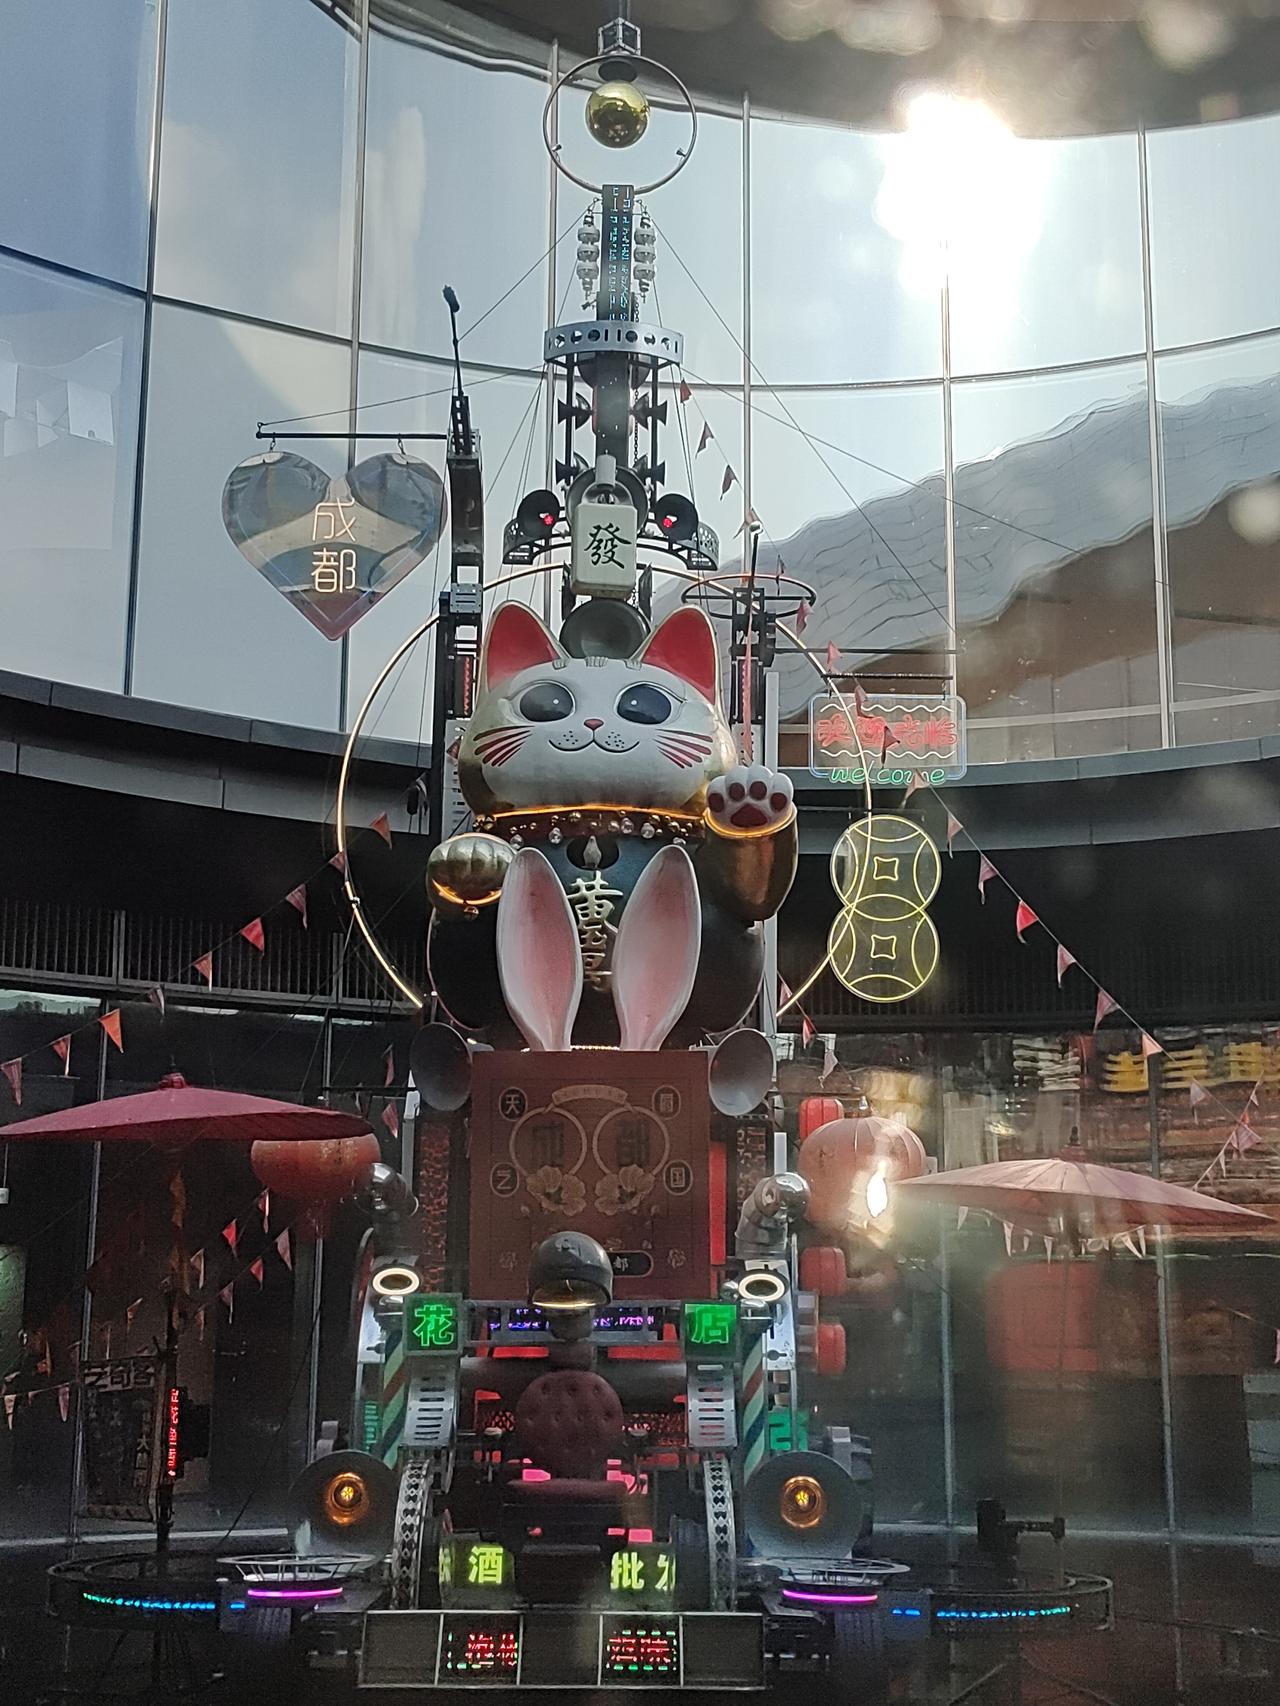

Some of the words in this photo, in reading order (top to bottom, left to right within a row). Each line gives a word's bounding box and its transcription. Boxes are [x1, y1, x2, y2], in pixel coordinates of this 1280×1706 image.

[311, 496, 357, 594] 成都
[584, 522, 632, 570] 發
[504, 1093, 520, 1115] 天
[413, 1304, 454, 1347] 花
[691, 1306, 729, 1344] 店
